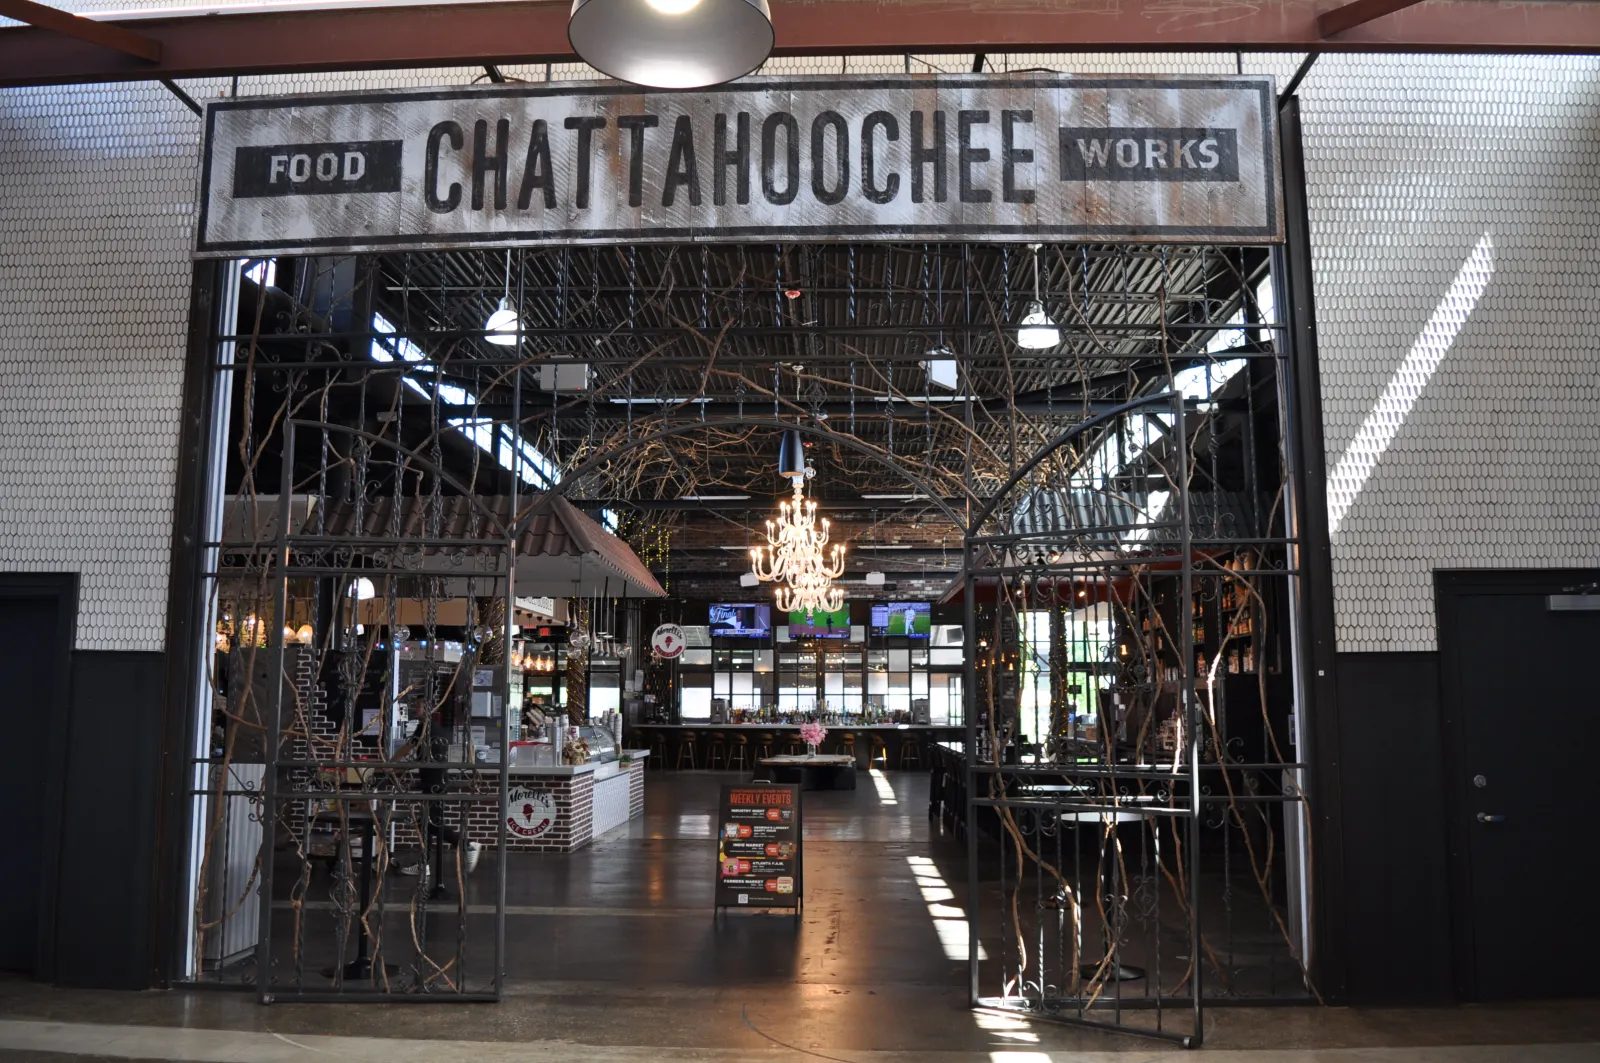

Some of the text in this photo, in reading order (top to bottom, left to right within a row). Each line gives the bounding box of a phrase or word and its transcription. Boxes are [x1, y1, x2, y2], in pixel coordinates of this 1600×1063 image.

[269, 108, 1220, 214] FOOD CHATTAHOOCHEE WORKS
[508, 790, 549, 808] Morelli's
[730, 793, 792, 805] WEEKLY EVENTS
[509, 821, 547, 835] ICE CREAM
